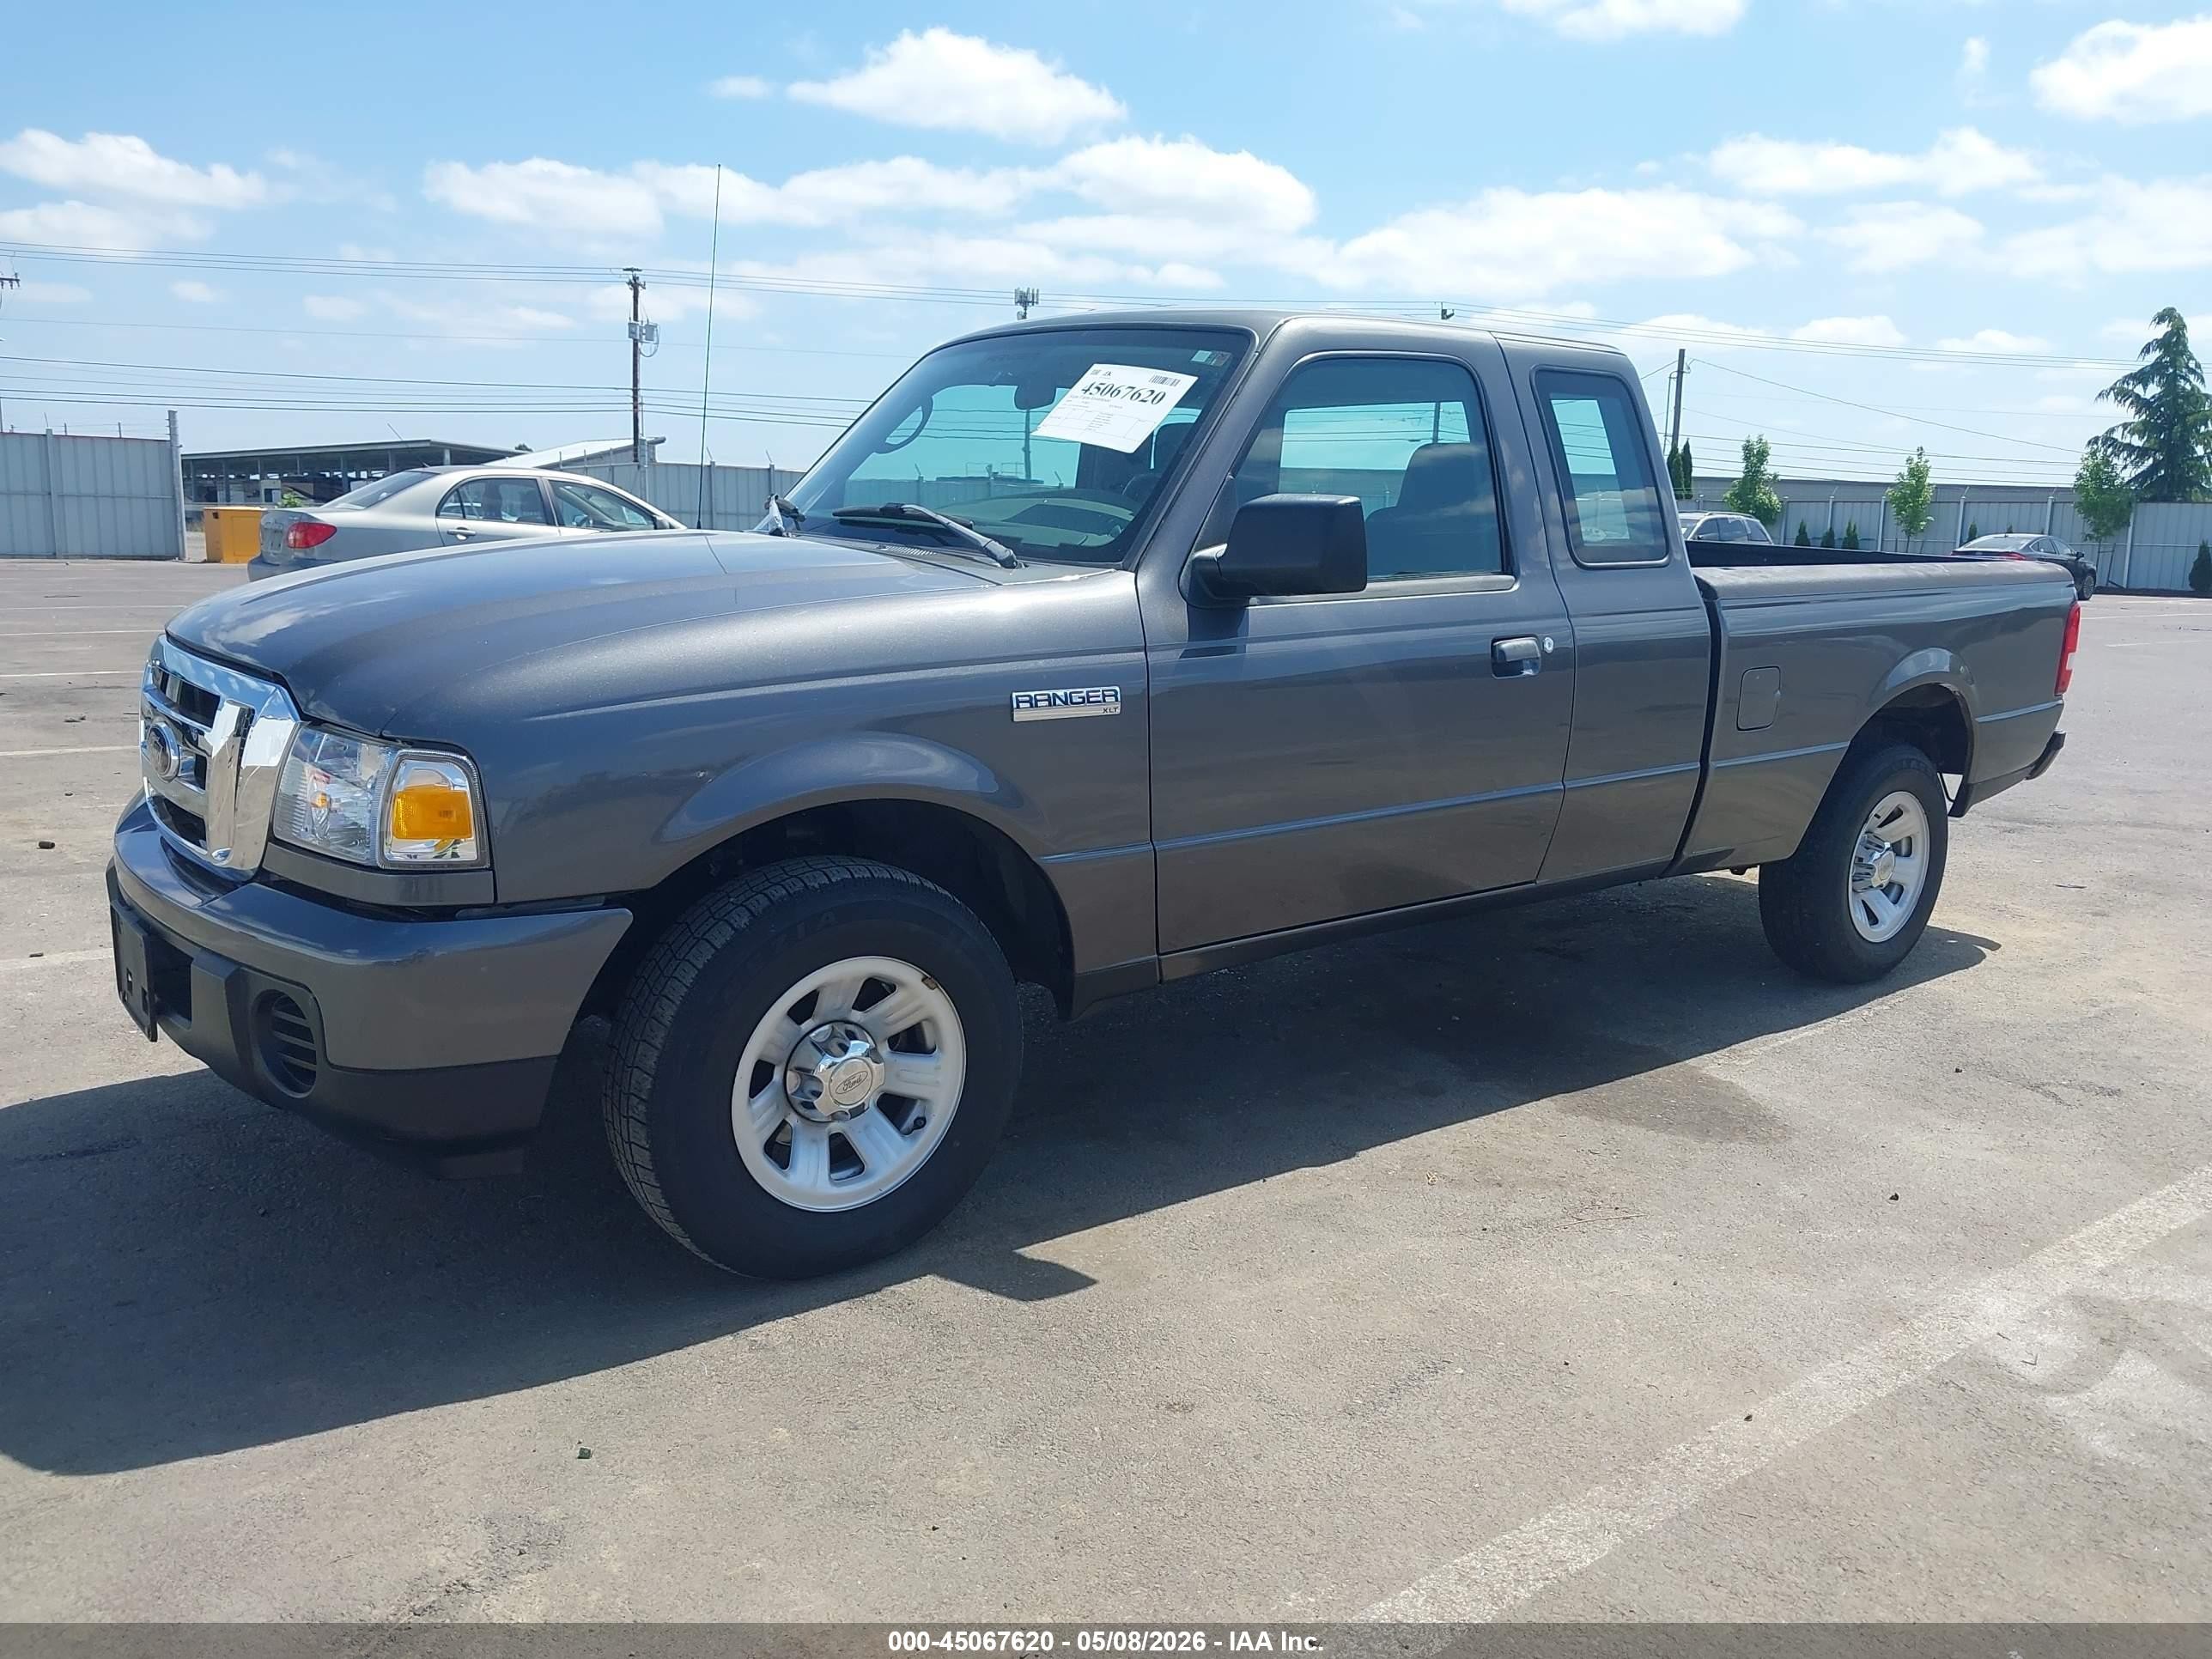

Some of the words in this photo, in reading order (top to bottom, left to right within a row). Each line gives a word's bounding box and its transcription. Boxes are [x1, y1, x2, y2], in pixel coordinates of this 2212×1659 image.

[1080, 380, 1167, 405] 45067620
[1015, 688, 1120, 709] RANGER
[1102, 706, 1120, 714] XLT
